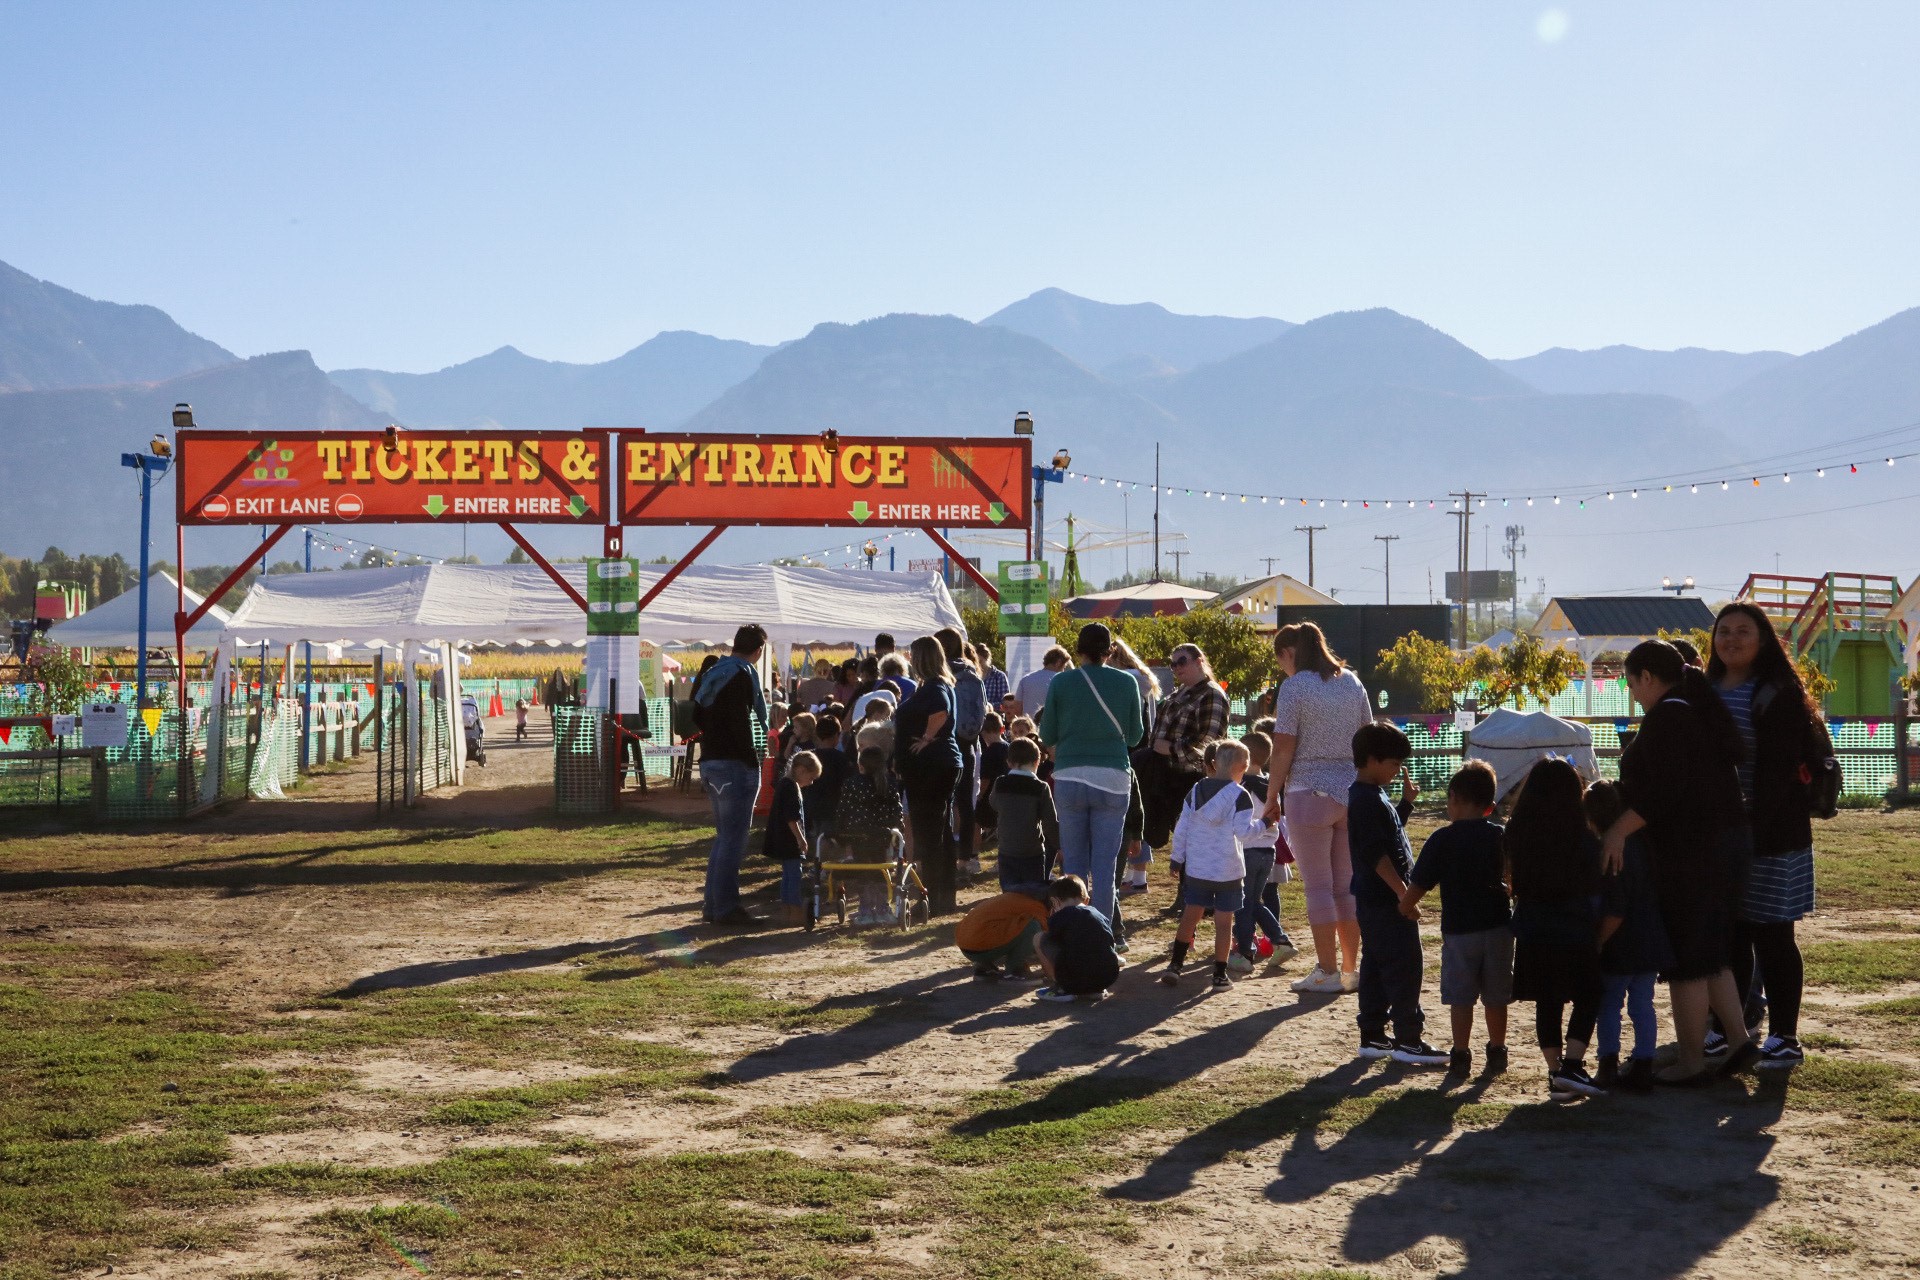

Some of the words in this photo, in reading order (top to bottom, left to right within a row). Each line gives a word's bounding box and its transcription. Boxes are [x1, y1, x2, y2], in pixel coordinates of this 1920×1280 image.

[317, 440, 541, 481] TICKETS
[561, 438, 596, 481] &
[628, 442, 905, 484] ENTRANCE
[235, 498, 275, 514] EXIT
[280, 498, 330, 514] LANE
[454, 497, 510, 514] ENTER
[515, 497, 561, 514] HERE
[878, 504, 931, 520] ENTER
[937, 504, 981, 520] HERE
